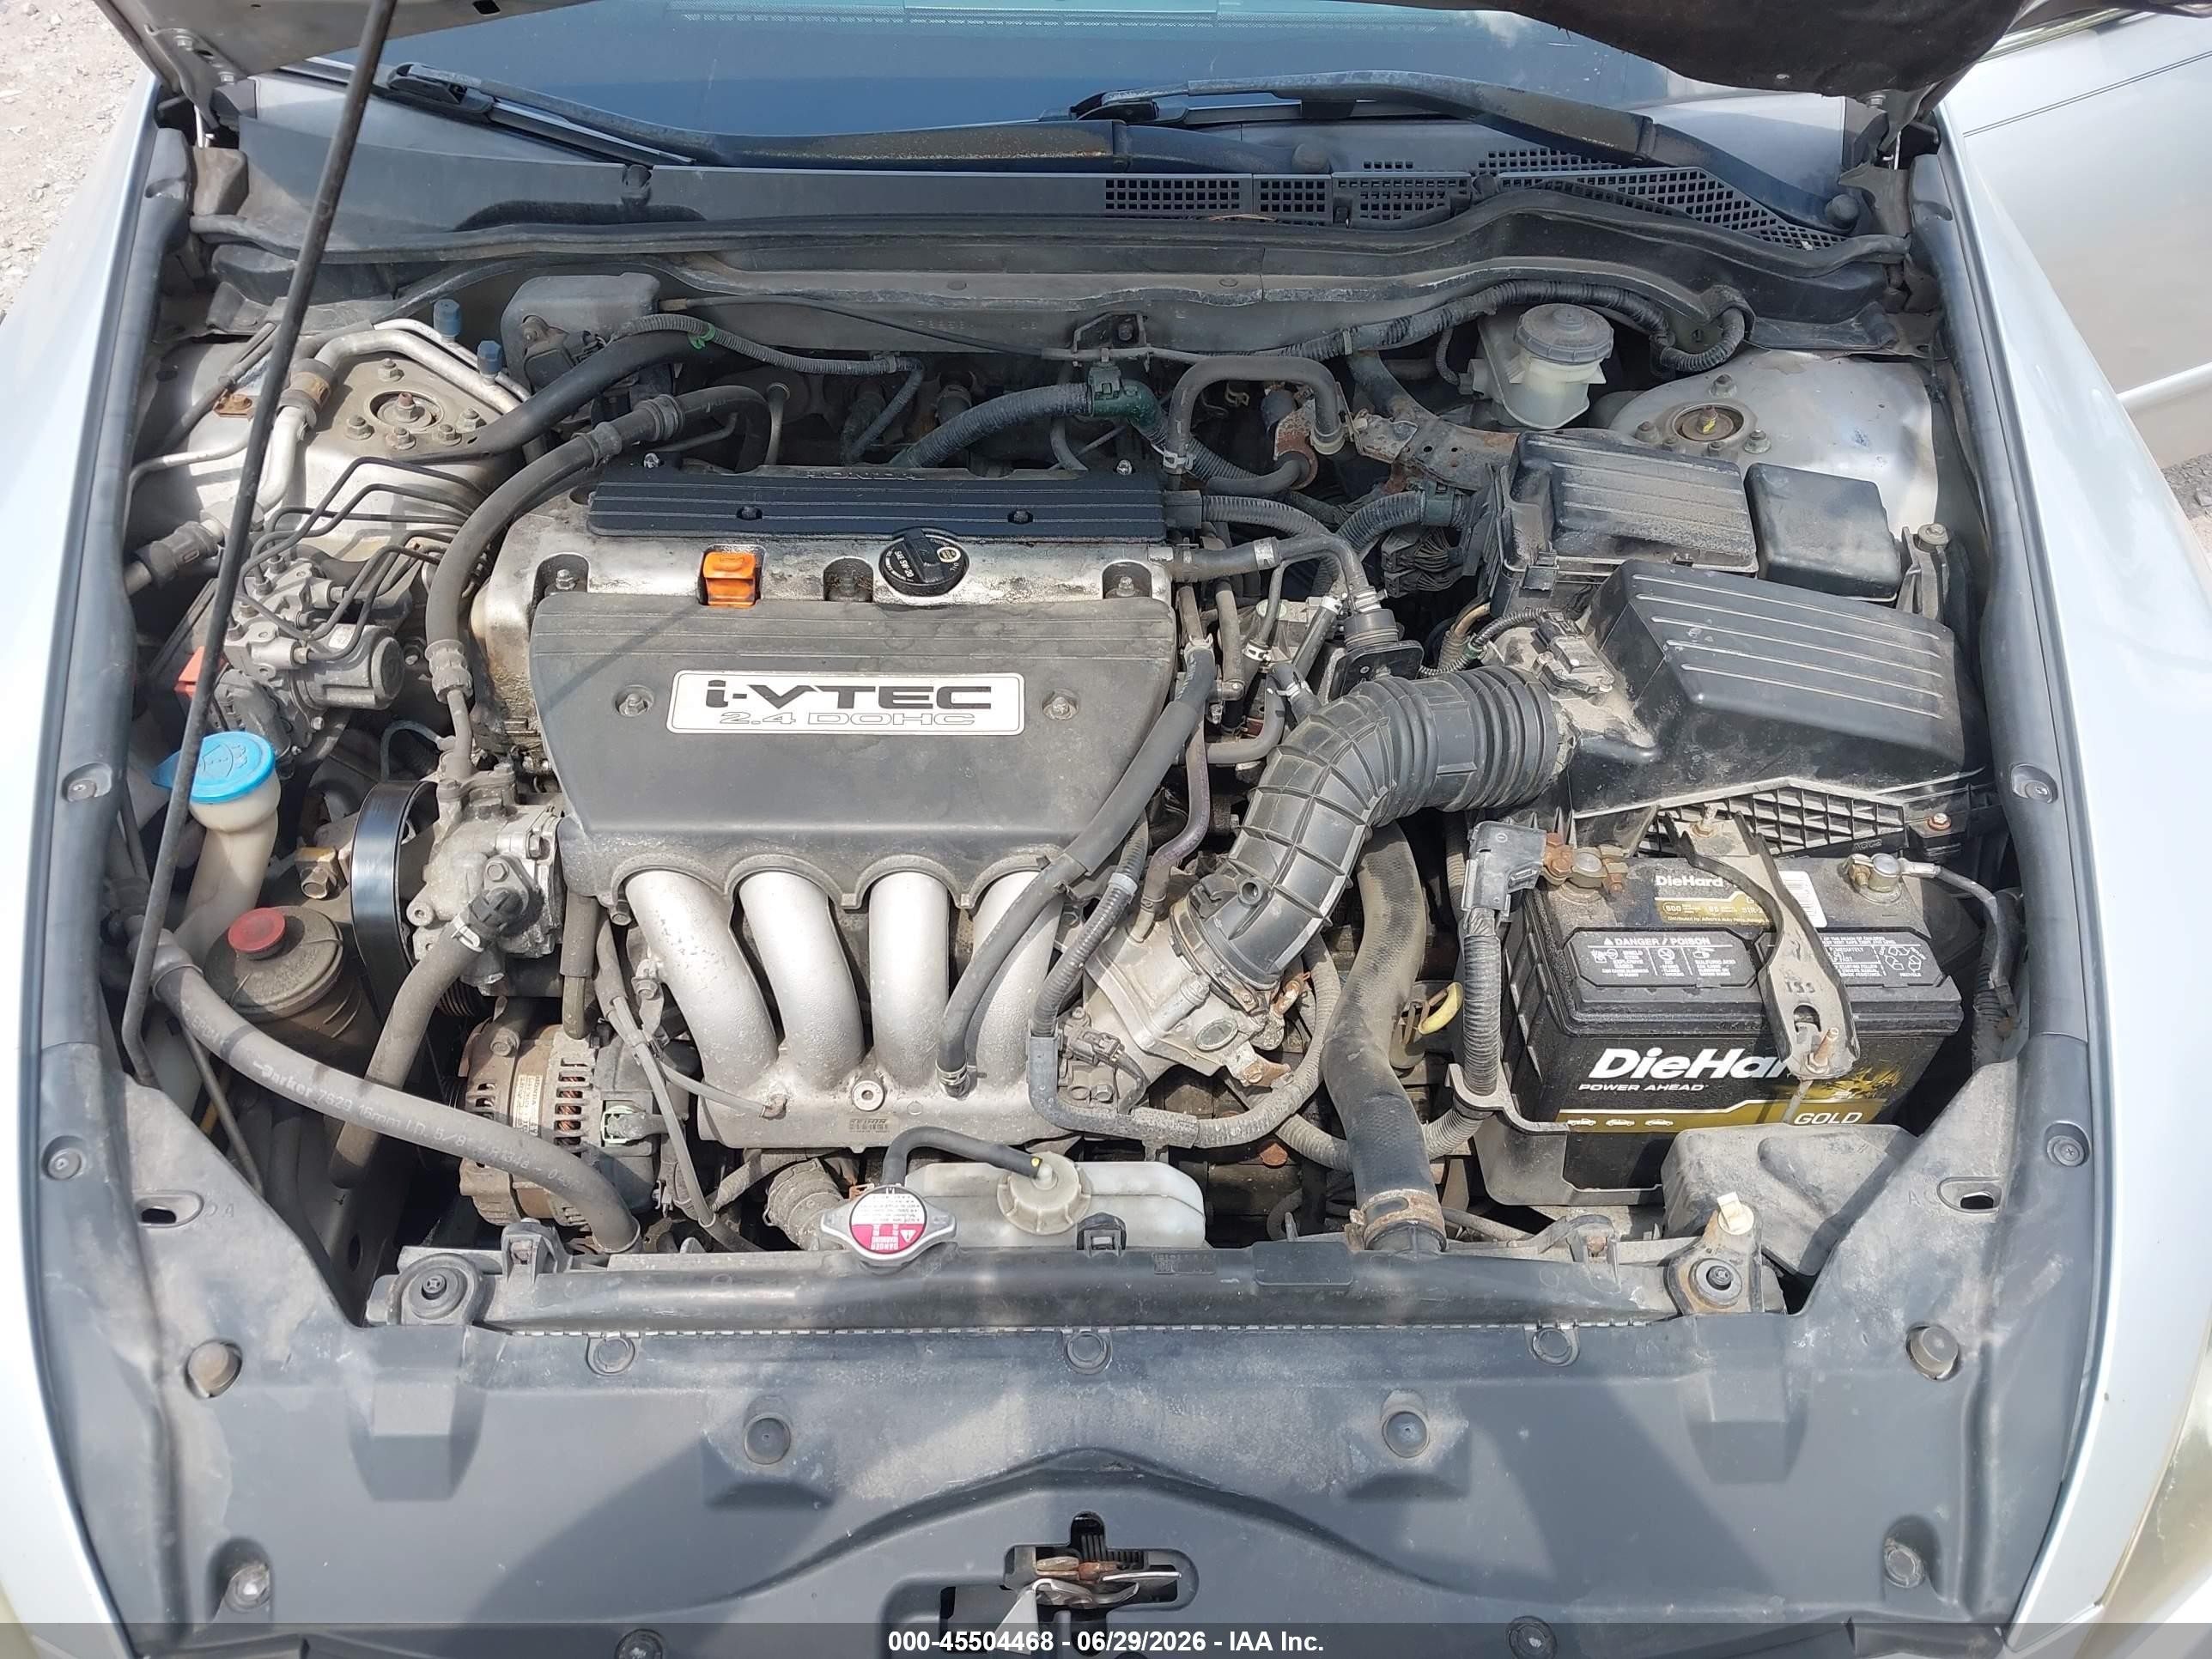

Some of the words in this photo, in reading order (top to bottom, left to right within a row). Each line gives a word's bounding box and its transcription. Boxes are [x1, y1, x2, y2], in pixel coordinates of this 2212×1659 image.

[900, 561, 915, 578] 5W-20
[705, 679, 992, 710] i-VTEC
[720, 711, 797, 725] 2.4
[808, 712, 975, 726] DOHC
[1656, 875, 1723, 888] DieHard
[1589, 1048, 1791, 1079] DieHar
[1578, 1084, 1641, 1092] POWER
[1644, 1083, 1705, 1092] AHEAD
[358, 1104, 401, 1128] 16mm
[1794, 1112, 1863, 1125] GOLD
